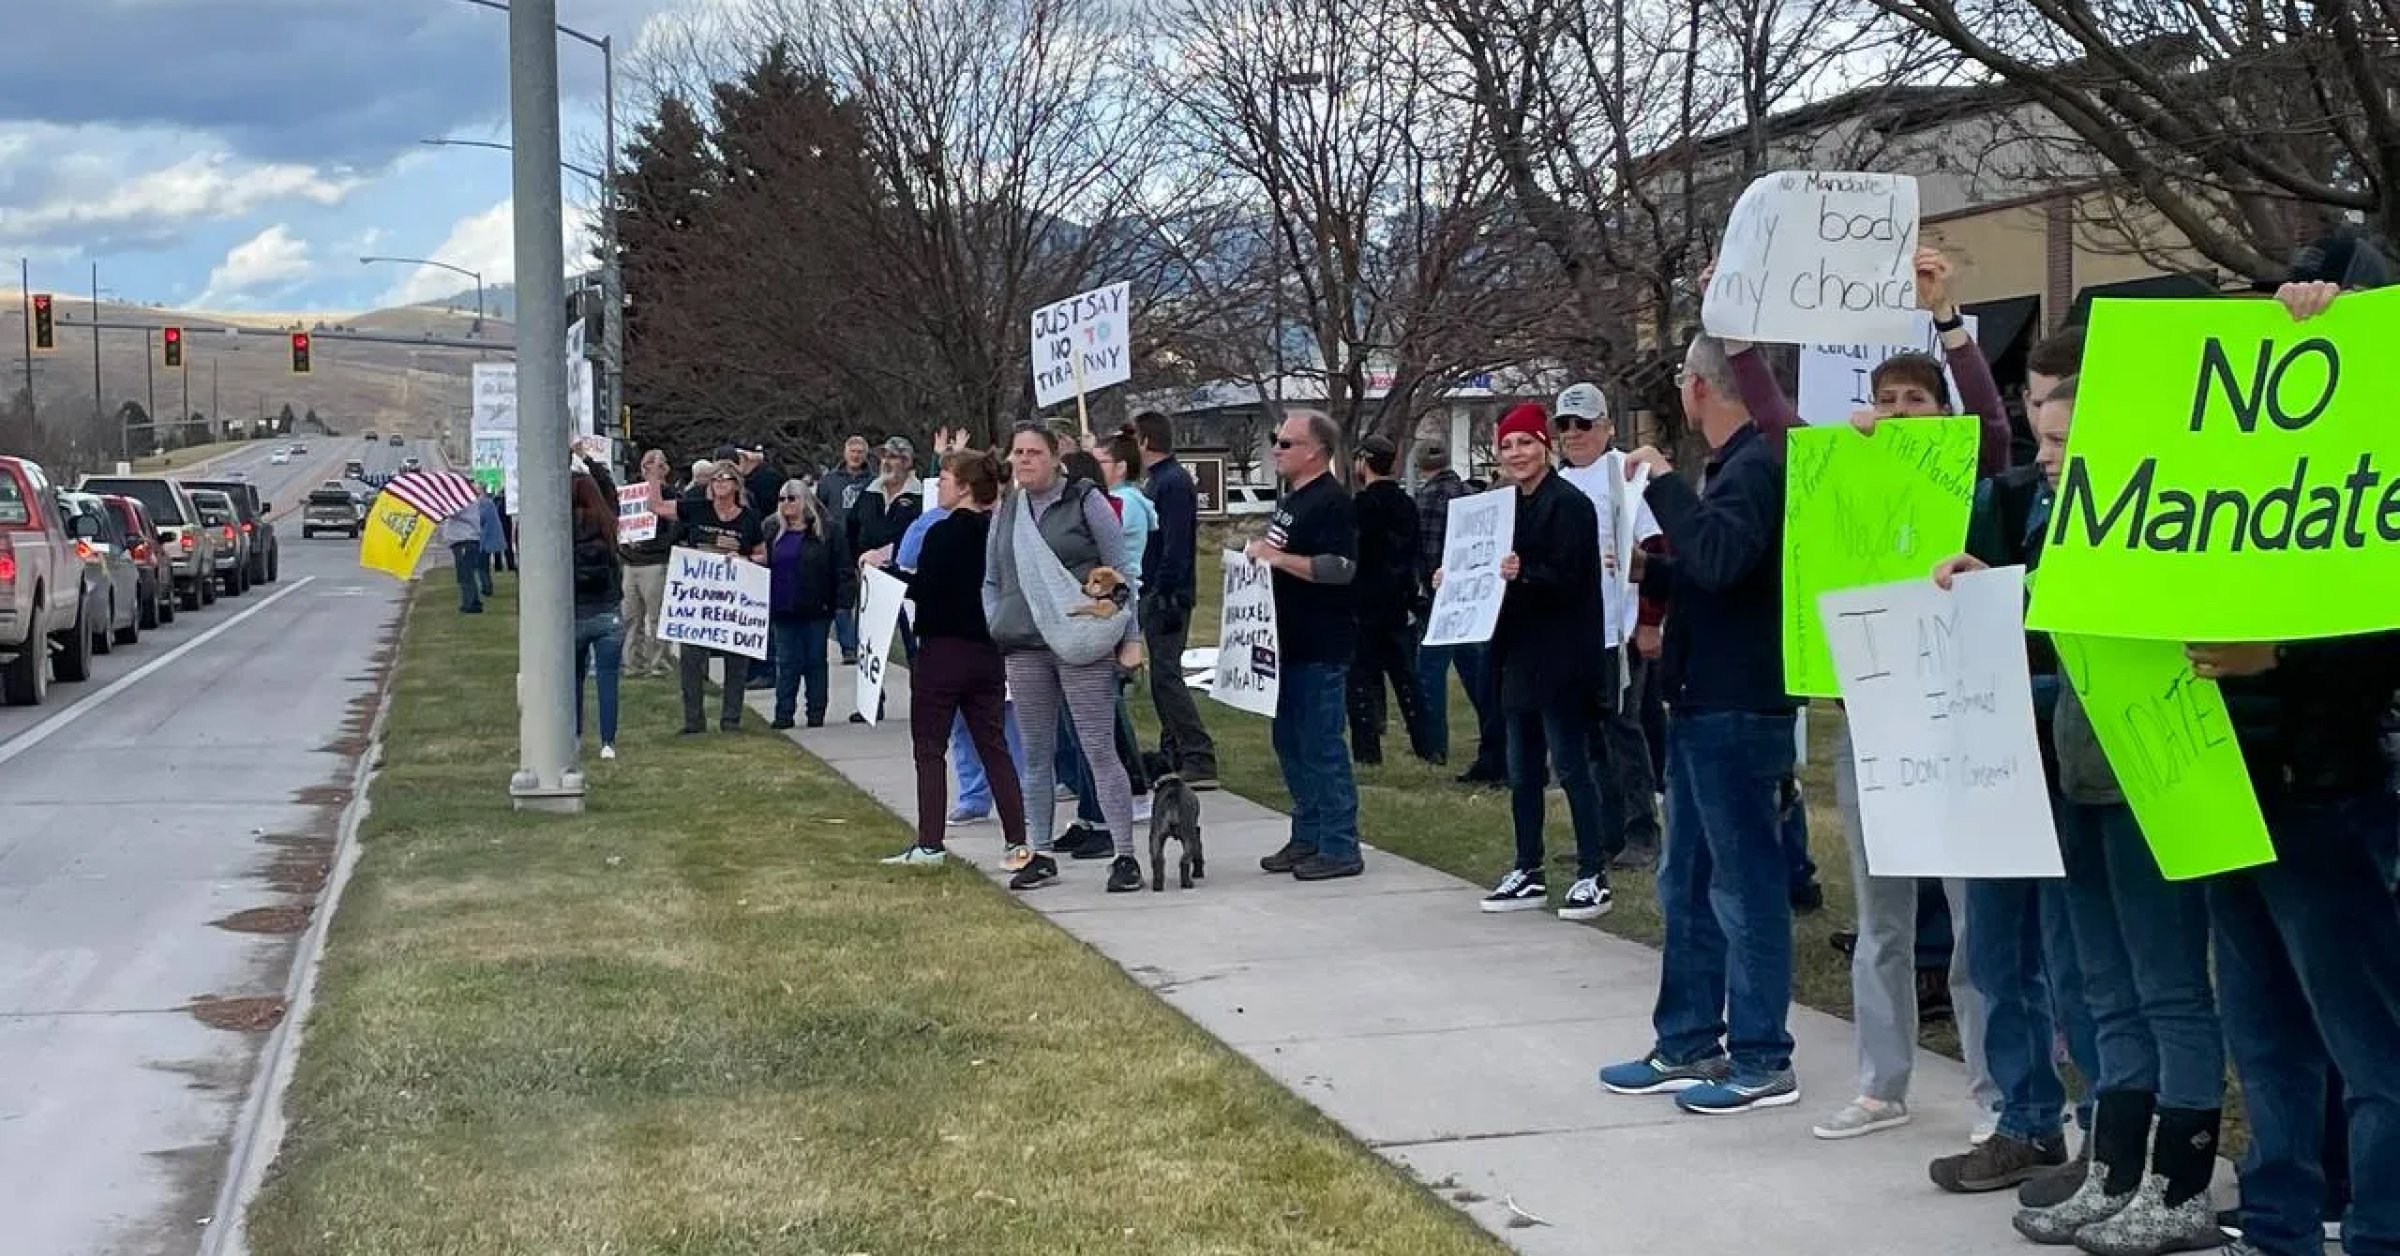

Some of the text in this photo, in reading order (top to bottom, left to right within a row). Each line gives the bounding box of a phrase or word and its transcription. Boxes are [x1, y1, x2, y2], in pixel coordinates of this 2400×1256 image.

[1818, 195, 1914, 275] body
[1035, 287, 1124, 339] JUST SAY
[1712, 257, 1918, 334] my choice
[1050, 321, 1111, 361] NO TO
[1037, 345, 1121, 391] TYRANNY
[2189, 336, 2341, 433] NO
[683, 555, 738, 582] WHEN
[1837, 608, 1966, 682] I AM
[1859, 756, 1886, 792] I
